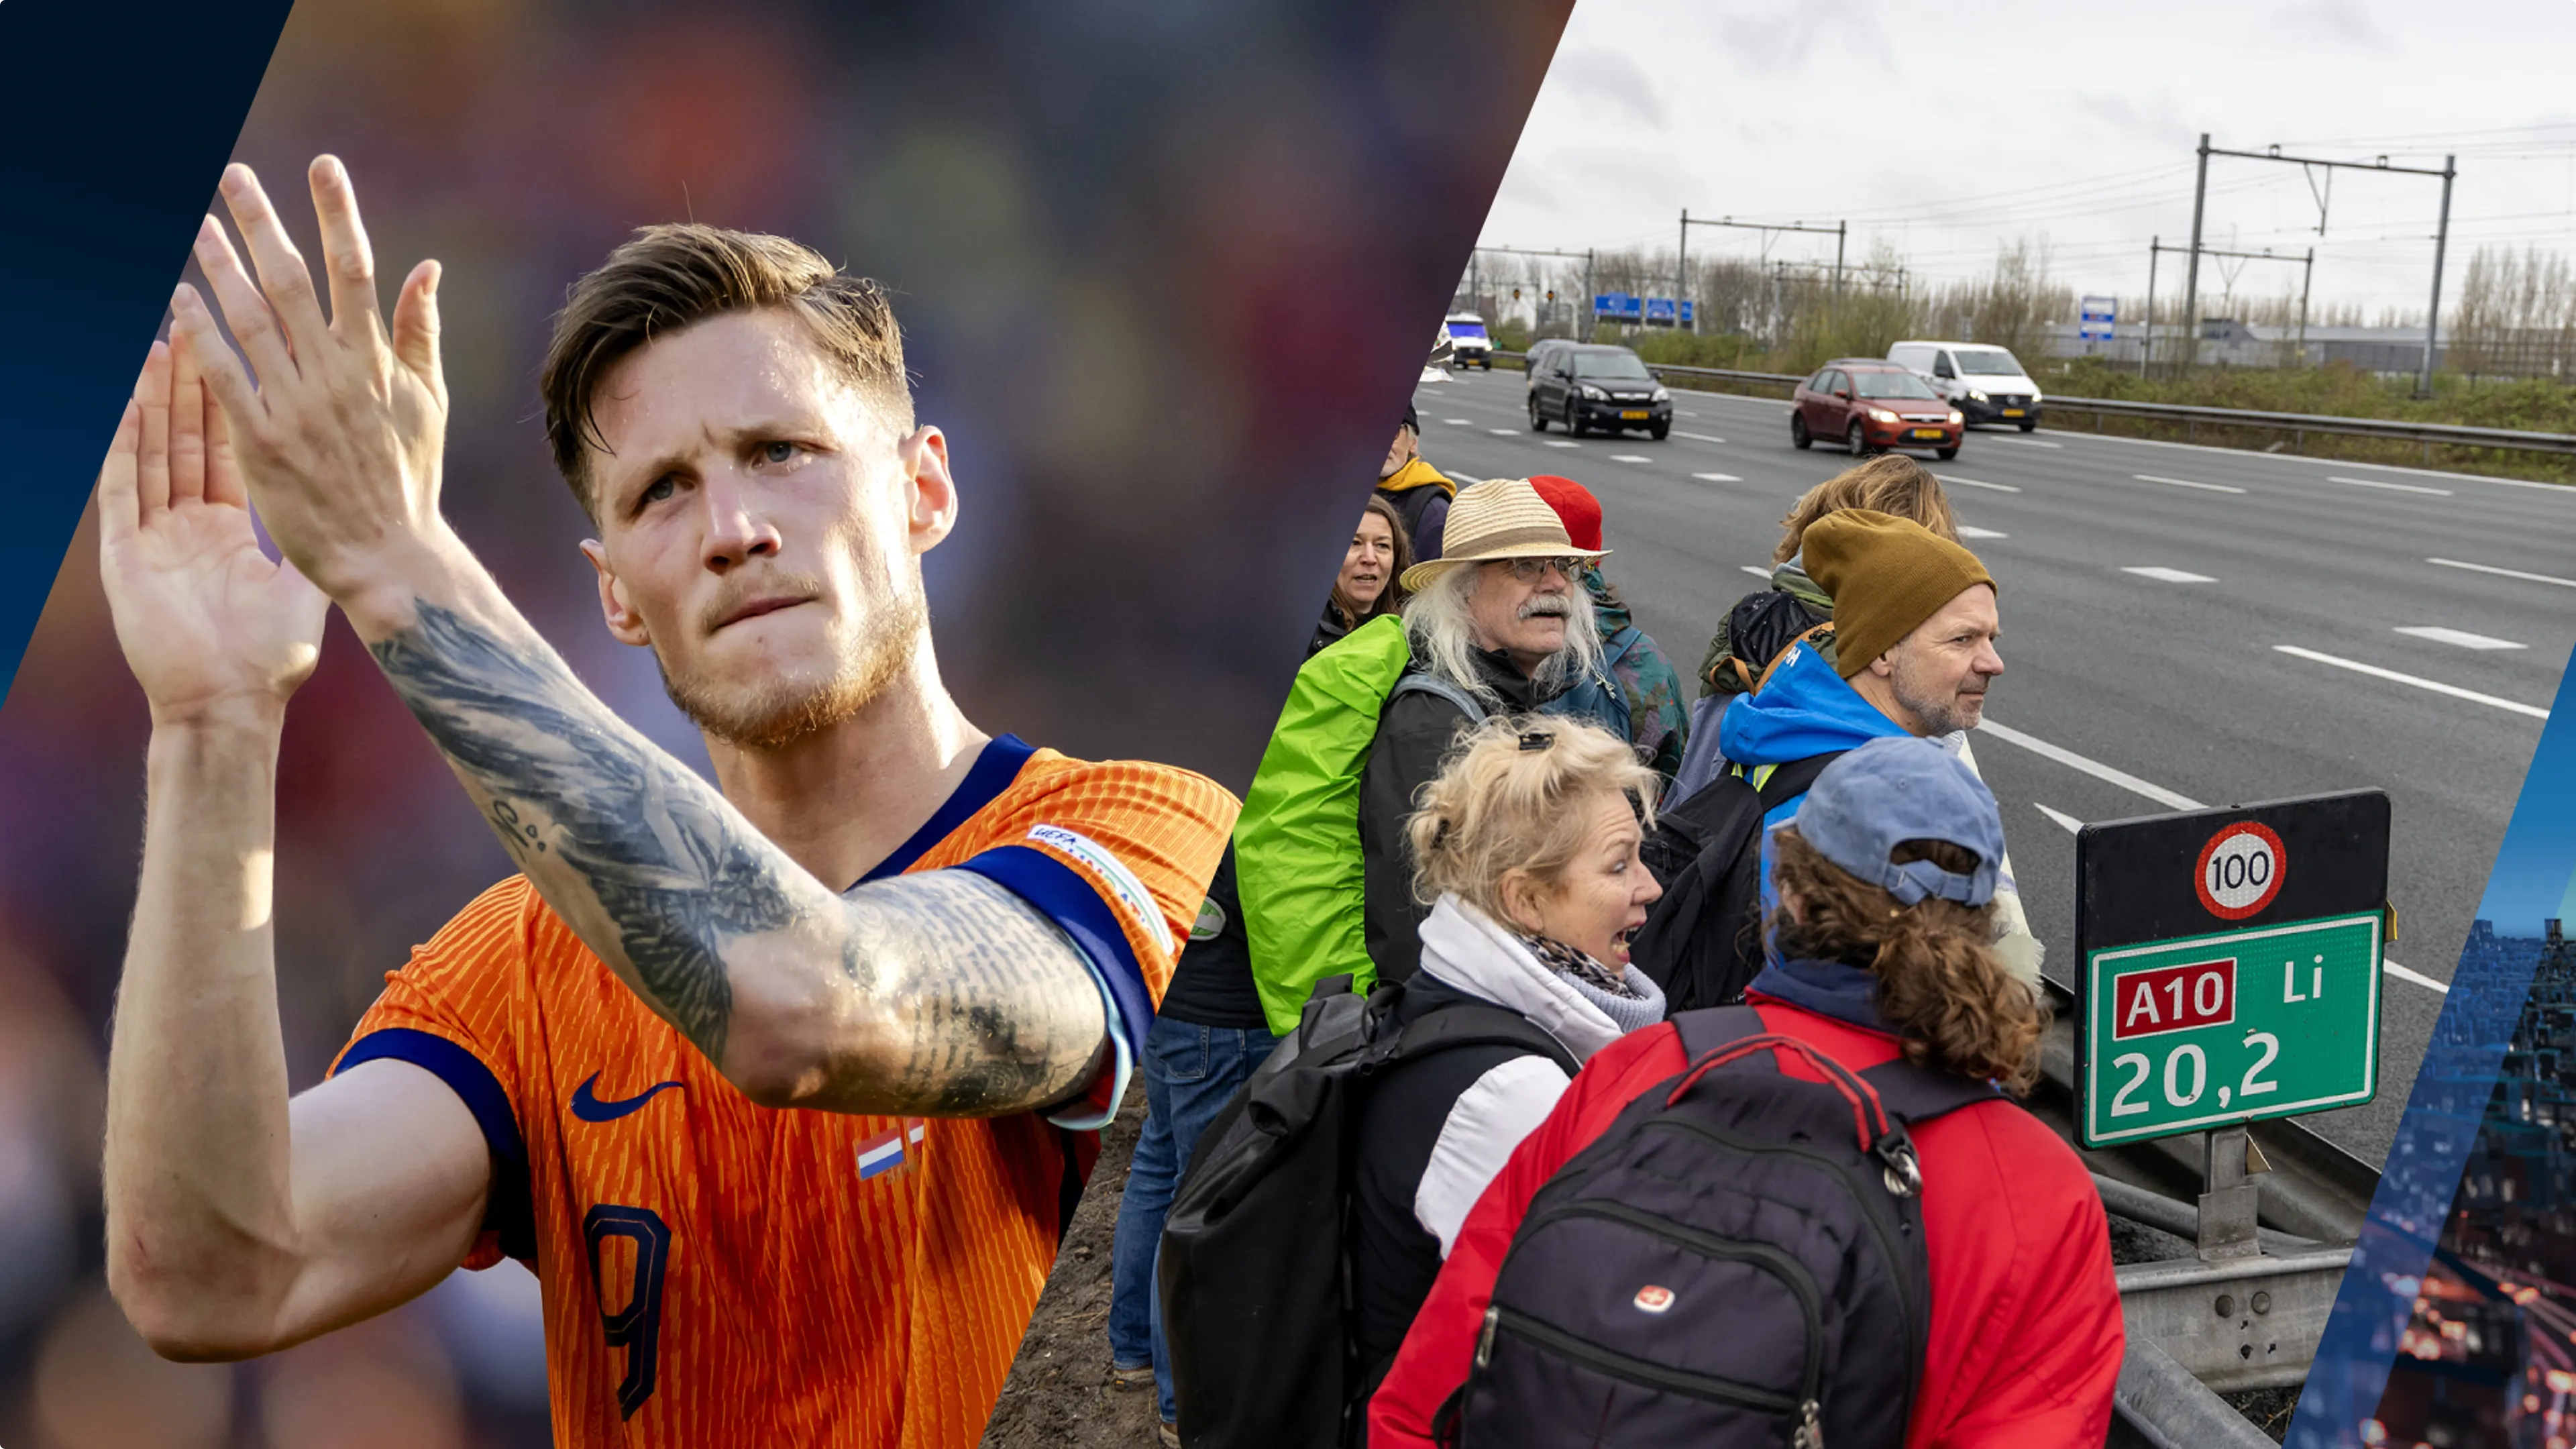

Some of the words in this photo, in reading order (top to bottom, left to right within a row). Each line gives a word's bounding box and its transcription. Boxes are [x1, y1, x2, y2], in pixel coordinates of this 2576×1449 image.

[1034, 828, 1076, 845] UEFA
[2212, 851, 2269, 891] 100
[2125, 971, 2224, 1027] A10
[2284, 955, 2323, 1003] Li
[2110, 1032, 2279, 1117] 20,2
[583, 1203, 672, 1421] 9
